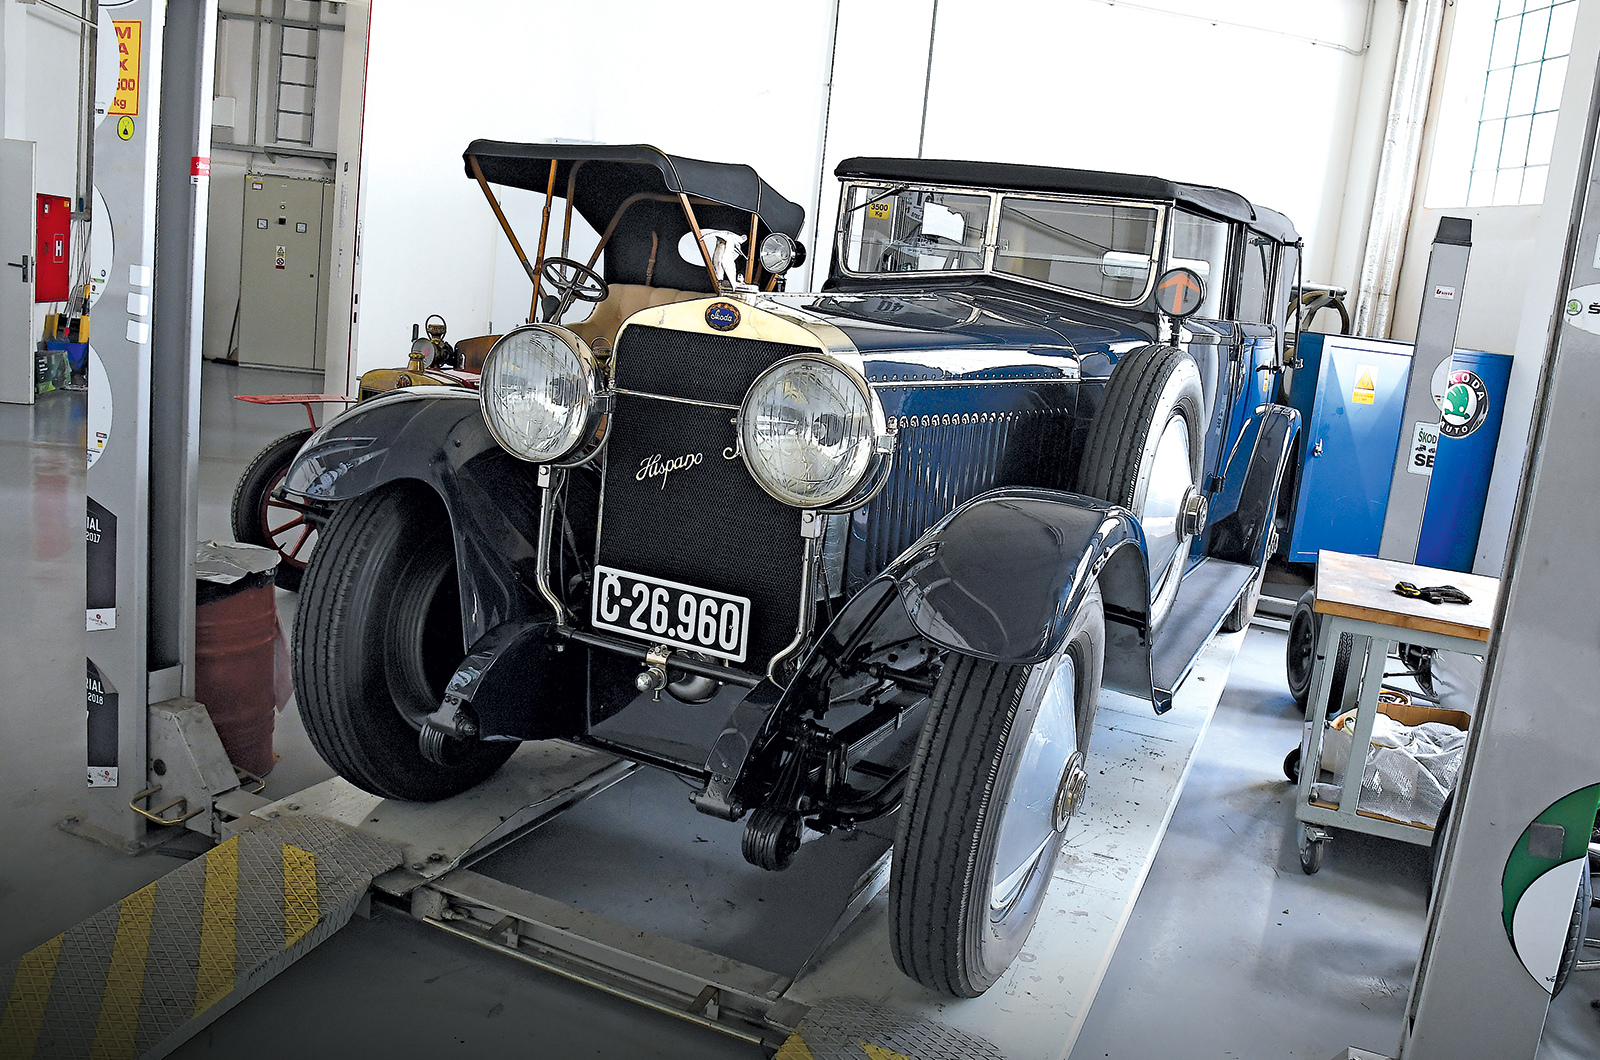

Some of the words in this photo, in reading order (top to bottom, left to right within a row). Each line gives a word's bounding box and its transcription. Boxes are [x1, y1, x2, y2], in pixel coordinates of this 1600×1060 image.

[113, 97, 127, 109] kg
[871, 203, 888, 212] 3500
[55, 240, 63, 256] H
[636, 453, 703, 490] Hispano
[86, 532, 101, 543] 2017
[88, 693, 104, 705] 2018
